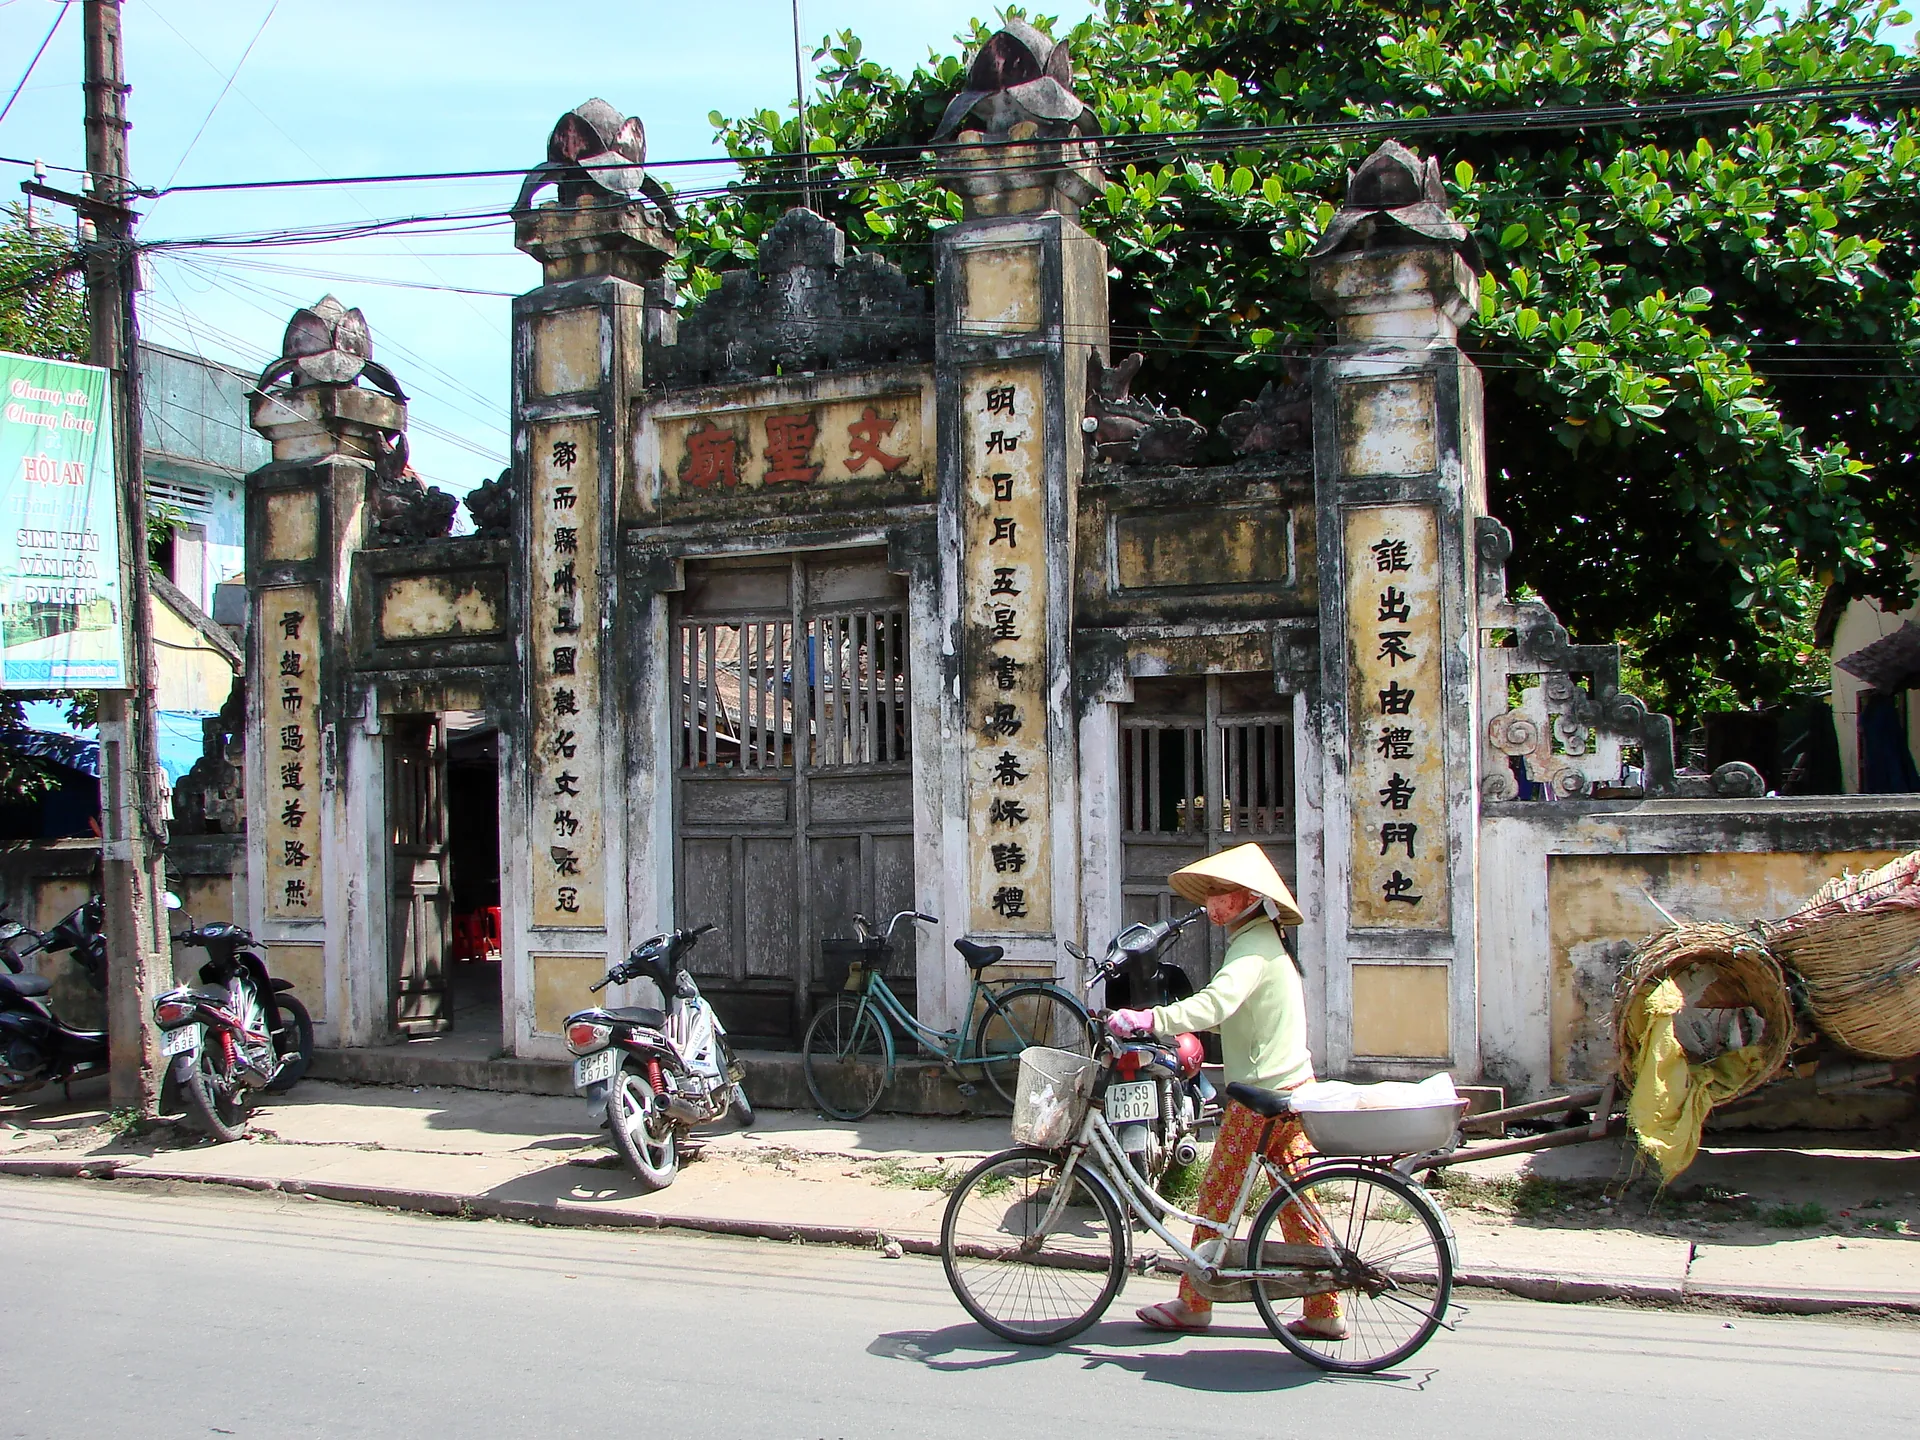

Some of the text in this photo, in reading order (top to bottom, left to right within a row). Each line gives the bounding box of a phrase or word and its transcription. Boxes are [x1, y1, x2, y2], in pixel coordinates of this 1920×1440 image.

[12, 380, 61, 406] Chung
[8, 404, 57, 430] Chung
[24, 453, 84, 488] HỘI AN
[16, 528, 99, 551] SINH THÁI
[20, 553, 98, 579] VĂN HÓA
[25, 585, 49, 604] DU
[580, 1052, 609, 1071] 92-F8
[580, 1065, 609, 1084] 9876
[1113, 1085, 1149, 1103] 43-S9
[1114, 1101, 1150, 1119] 4802
